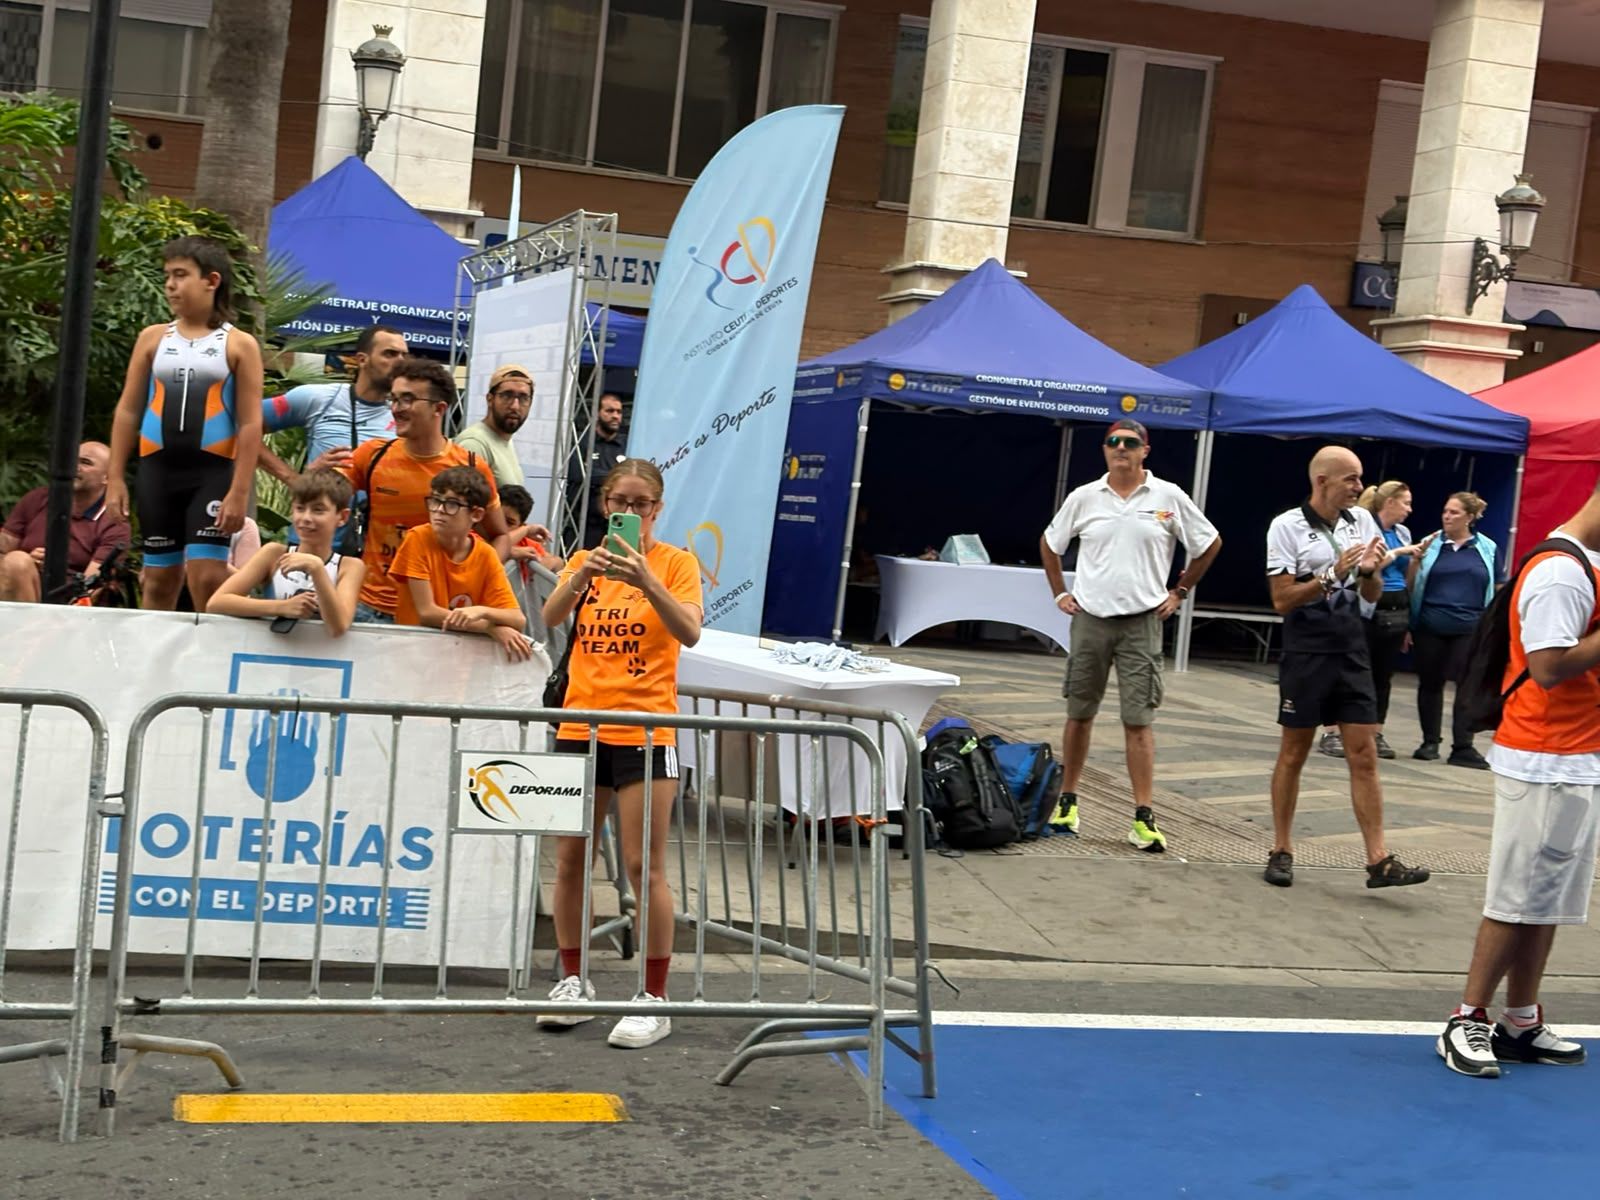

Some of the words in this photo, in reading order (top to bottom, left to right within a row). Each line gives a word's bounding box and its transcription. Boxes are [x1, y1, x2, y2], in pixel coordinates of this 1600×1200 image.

[756, 277, 798, 308] DEPORTES
[372, 314, 381, 325] Y
[323, 323, 341, 334] DE
[976, 374, 1043, 388] CRONOMETRAJE
[1043, 381, 1108, 394] ORGANIZACIÓN
[1038, 391, 1044, 399] Y
[968, 394, 1005, 406] GESTIÓN
[1006, 399, 1017, 407] DE
[1019, 400, 1056, 410] EVENTOS
[1057, 403, 1109, 416] DEPORTIVOS
[649, 441, 690, 474] euta
[711, 386, 776, 432] Deporte
[710, 579, 754, 611] DEPORTES
[594, 608, 629, 621] TRI
[579, 623, 646, 637] DINGO
[582, 640, 639, 654] TEAM
[509, 785, 582, 797] DEPORAMA
[135, 886, 201, 909] CON
[212, 889, 246, 911] EL
[261, 892, 393, 918] DEPORTE
